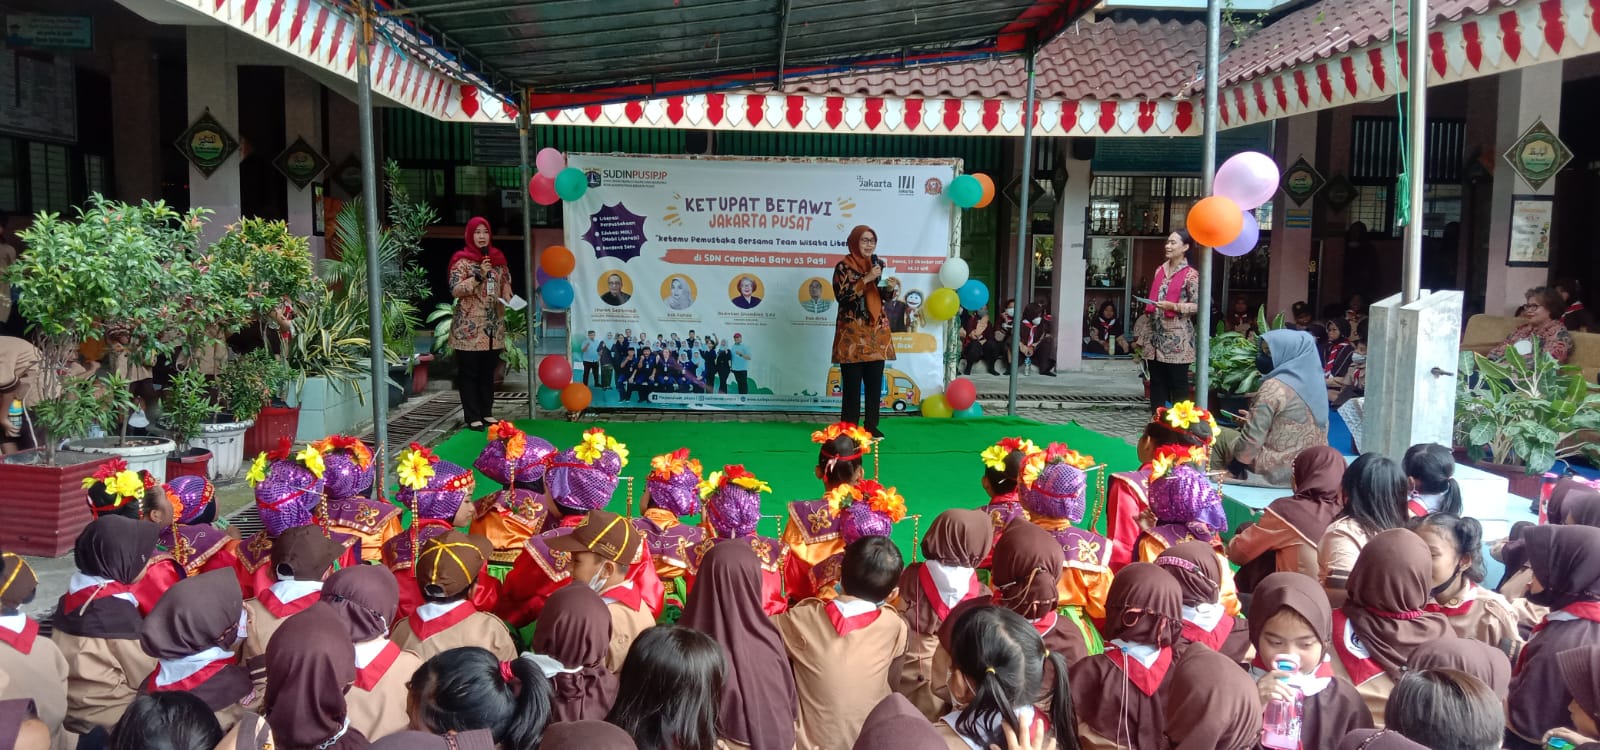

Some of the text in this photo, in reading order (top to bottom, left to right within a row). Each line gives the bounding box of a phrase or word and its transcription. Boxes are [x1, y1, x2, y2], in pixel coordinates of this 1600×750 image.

[603, 169, 668, 180] SUDINPUSIPJP
[859, 179, 892, 188] Jakarta
[685, 197, 833, 216] KETUPAT BETAWI
[709, 213, 813, 231] JAKARTA PUSAT
[691, 236, 736, 244] Pemustaka
[738, 237, 773, 246] Bersama
[776, 238, 797, 246] Team
[694, 254, 701, 262] di
[704, 254, 721, 262] SDN
[724, 255, 765, 265] Cempaka
[768, 256, 791, 264] Baru
[807, 257, 827, 265] Pagi
